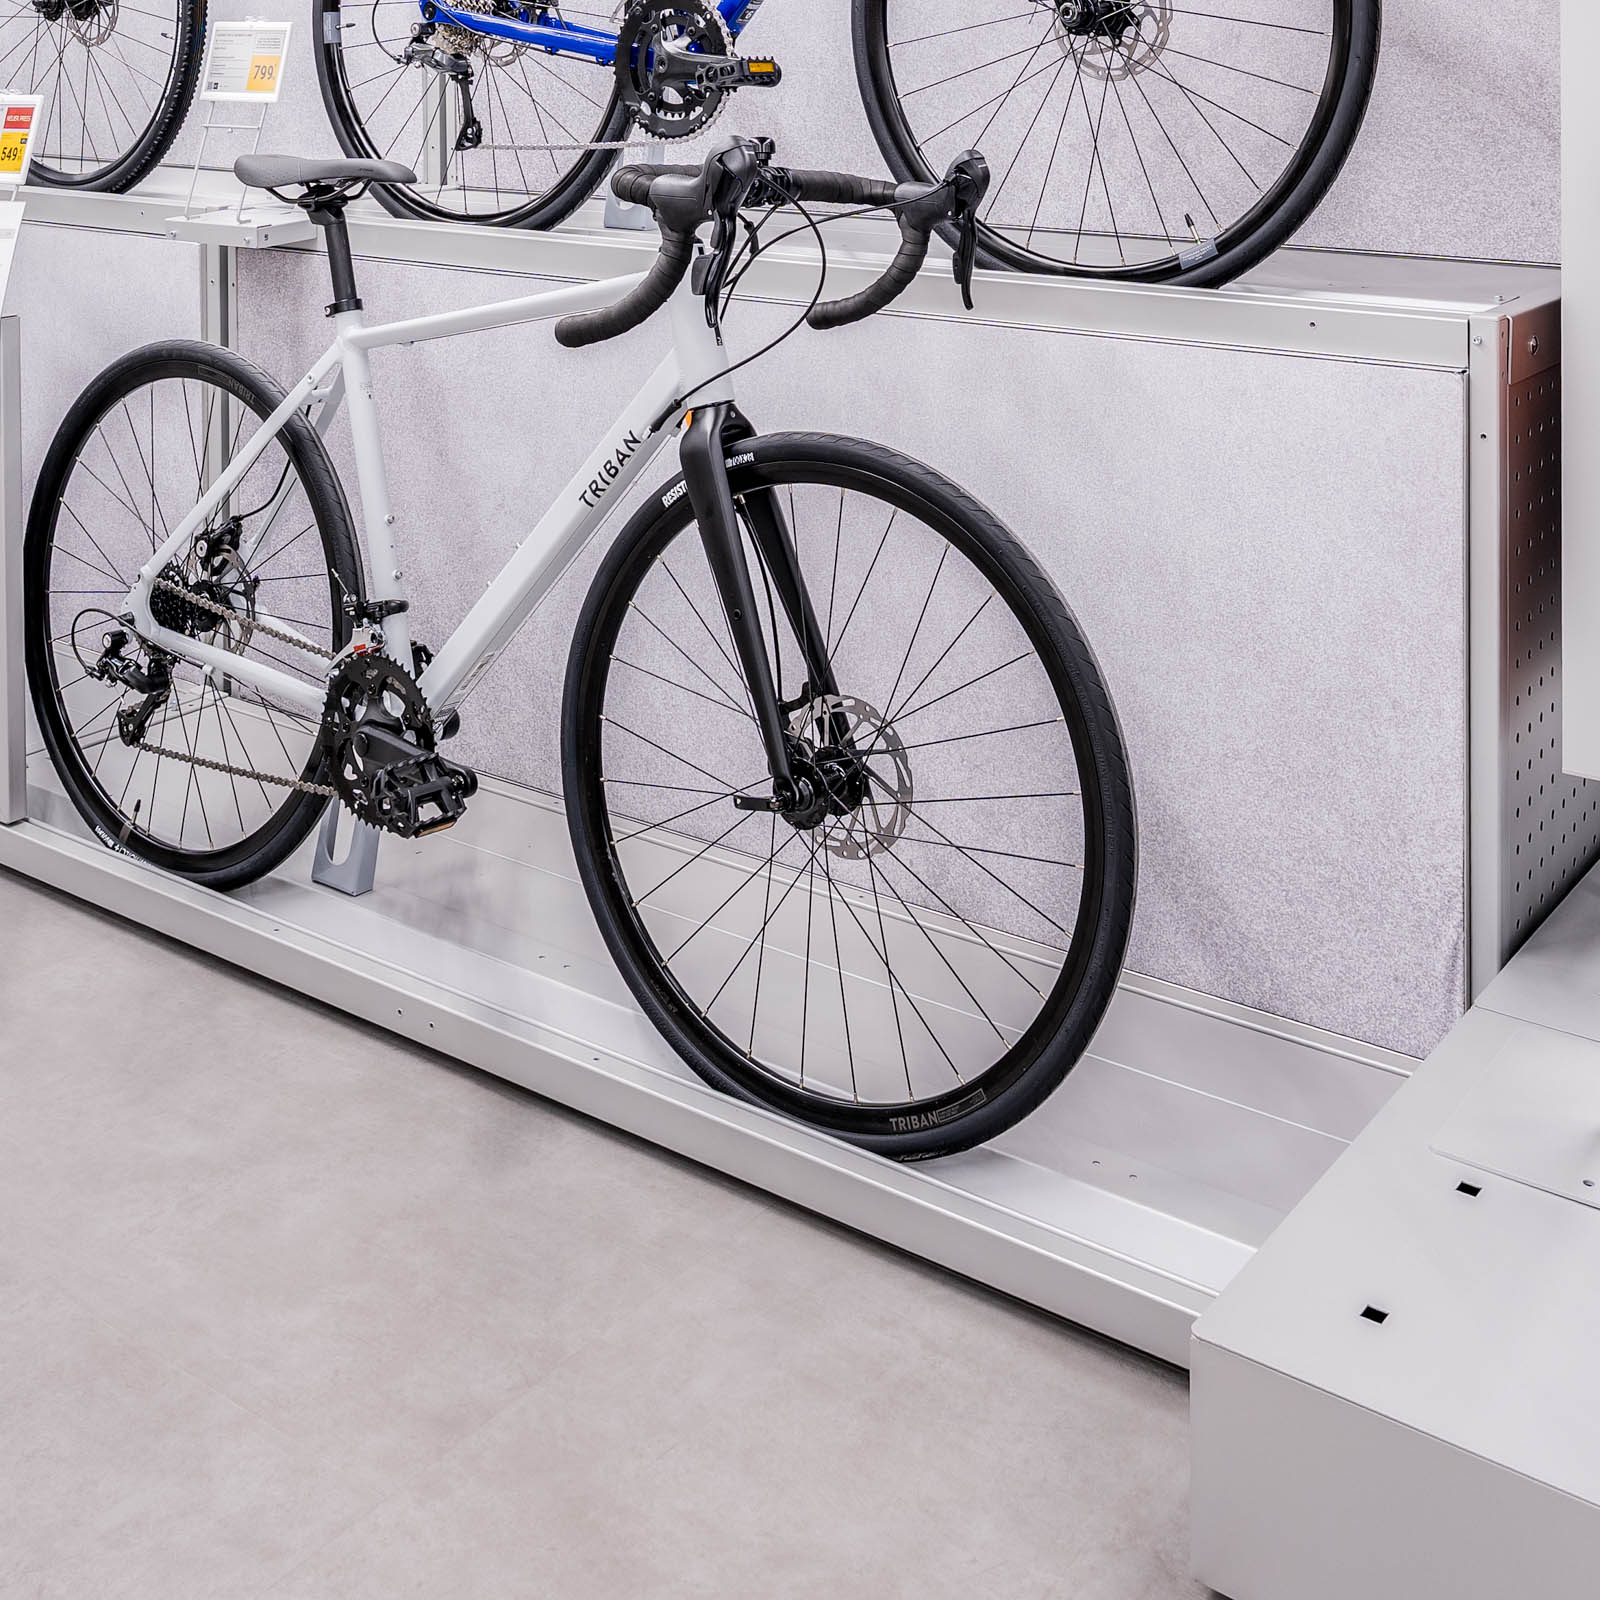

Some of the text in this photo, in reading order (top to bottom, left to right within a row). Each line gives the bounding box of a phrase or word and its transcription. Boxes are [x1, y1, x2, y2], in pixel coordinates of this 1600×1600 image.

[578, 428, 642, 509] TRIBAN
[661, 479, 688, 508] RESIST
[888, 1110, 938, 1132] TRIBAN
